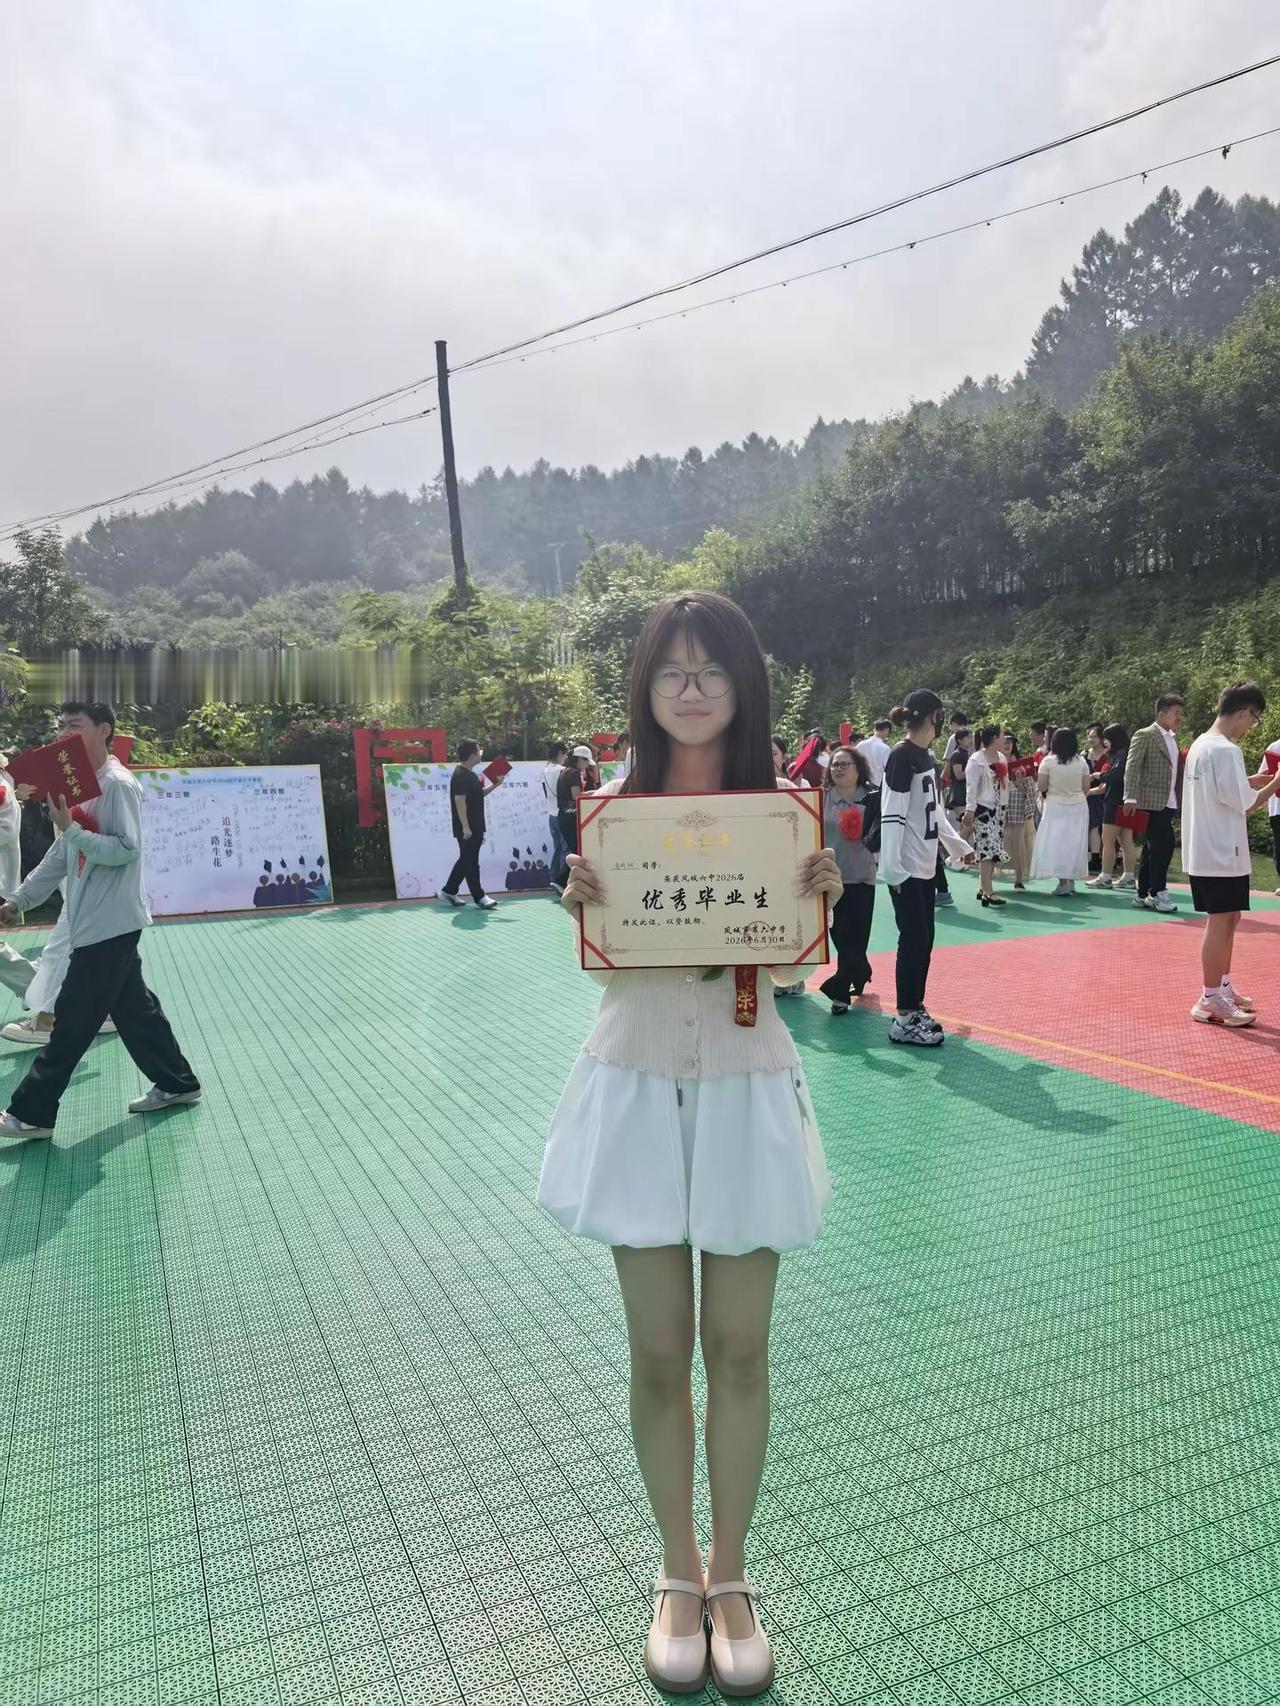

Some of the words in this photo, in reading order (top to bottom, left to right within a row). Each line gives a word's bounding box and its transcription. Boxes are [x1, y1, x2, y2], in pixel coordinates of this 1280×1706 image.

[58, 749, 82, 798] 荣誉证书
[222, 816, 233, 858] 追光逐梦
[641, 886, 769, 912] 优秀毕业生
